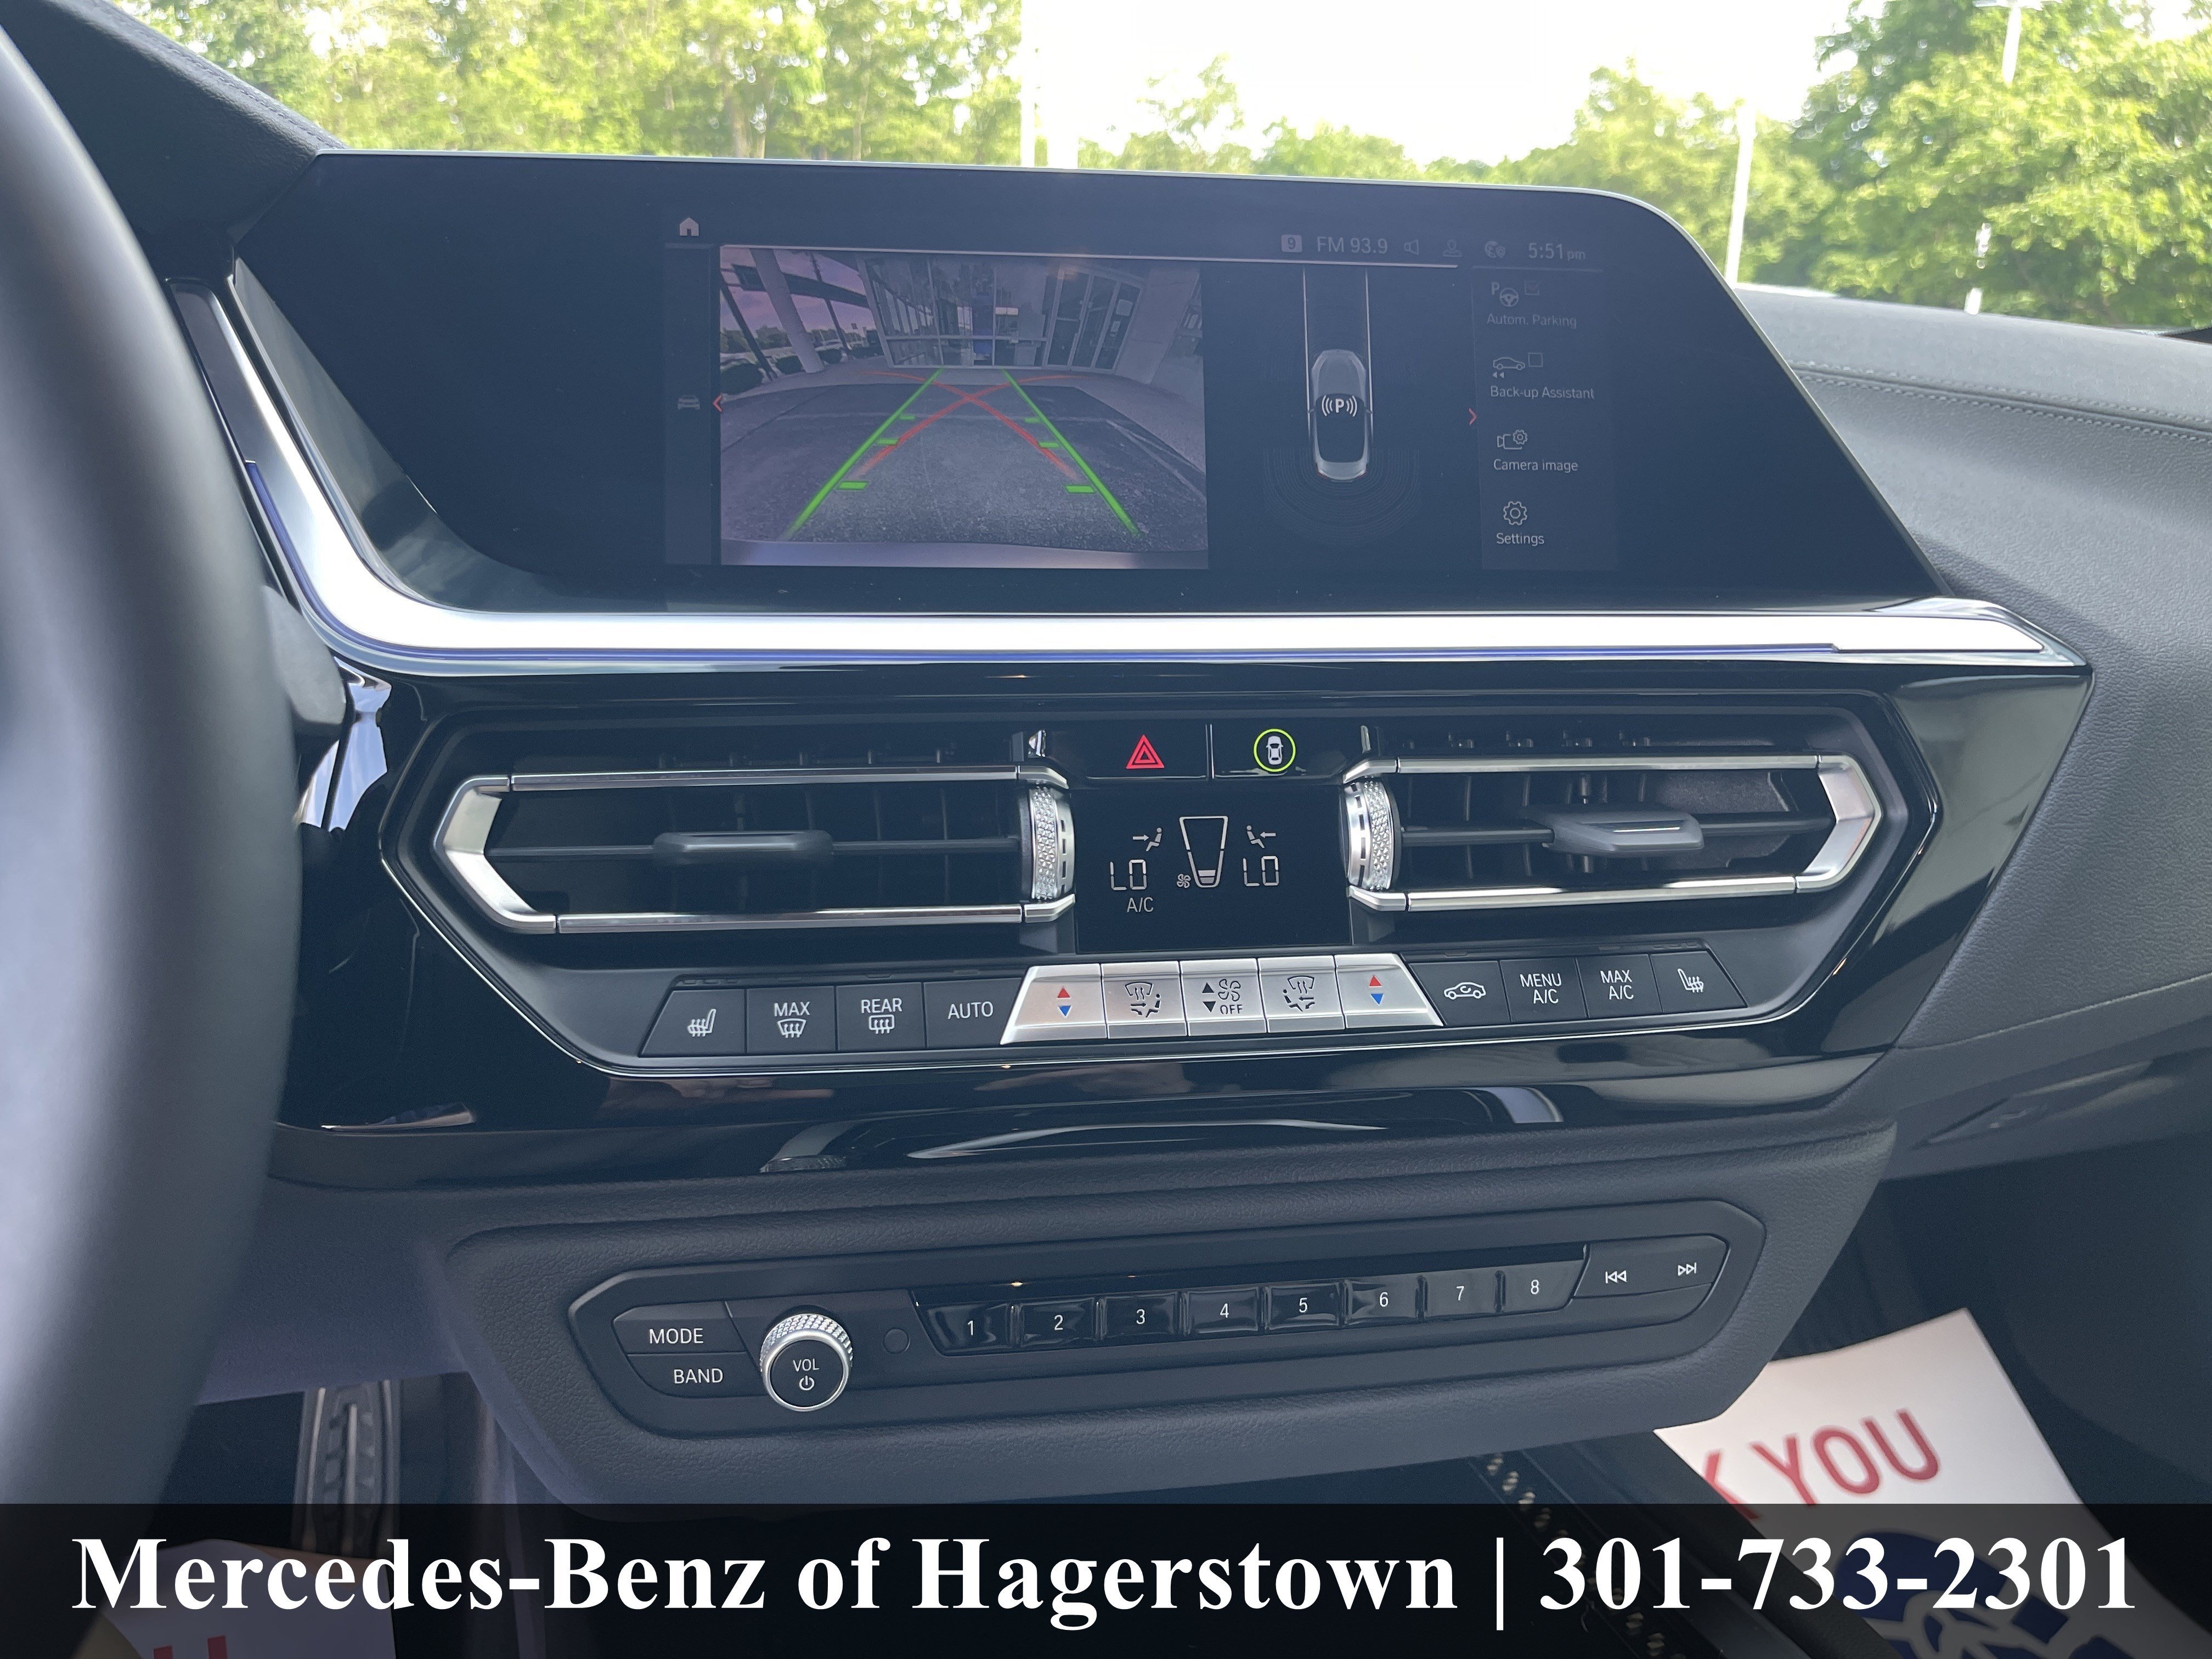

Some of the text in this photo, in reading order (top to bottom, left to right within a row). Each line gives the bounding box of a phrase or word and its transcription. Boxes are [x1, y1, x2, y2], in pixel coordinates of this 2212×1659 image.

[1316, 235, 1388, 255] FM 93.9
[1527, 241, 1585, 262] 5:51 pm
[1486, 311, 1577, 331] Autom. Parking
[1490, 385, 1595, 400] Back-up Assistant
[1493, 458, 1578, 473] Camera image
[1496, 532, 1545, 547] Settings
[1126, 896, 1154, 913] A/C
[1520, 973, 1562, 988] MENU
[1600, 969, 1633, 984] MAX
[1533, 988, 1559, 1004] A/C
[1609, 985, 1634, 1000] A/C
[774, 1001, 810, 1017] MAX
[860, 997, 902, 1014] REAR
[947, 1001, 994, 1020] AUTO
[1220, 1004, 1243, 1015] OFF
[1456, 1285, 1465, 1301] 7
[1530, 1279, 1540, 1295] 8
[1299, 1297, 1308, 1313] 5
[1379, 1291, 1389, 1307] 6
[1136, 1308, 1146, 1325] 3
[1220, 1303, 1229, 1318] 4
[967, 1320, 974, 1336] 1
[1054, 1314, 1064, 1330] 2
[649, 1328, 704, 1344] MODE
[792, 1358, 820, 1372] VOL
[674, 1368, 723, 1384] BAND
[1749, 1408, 1940, 1506] YOU
